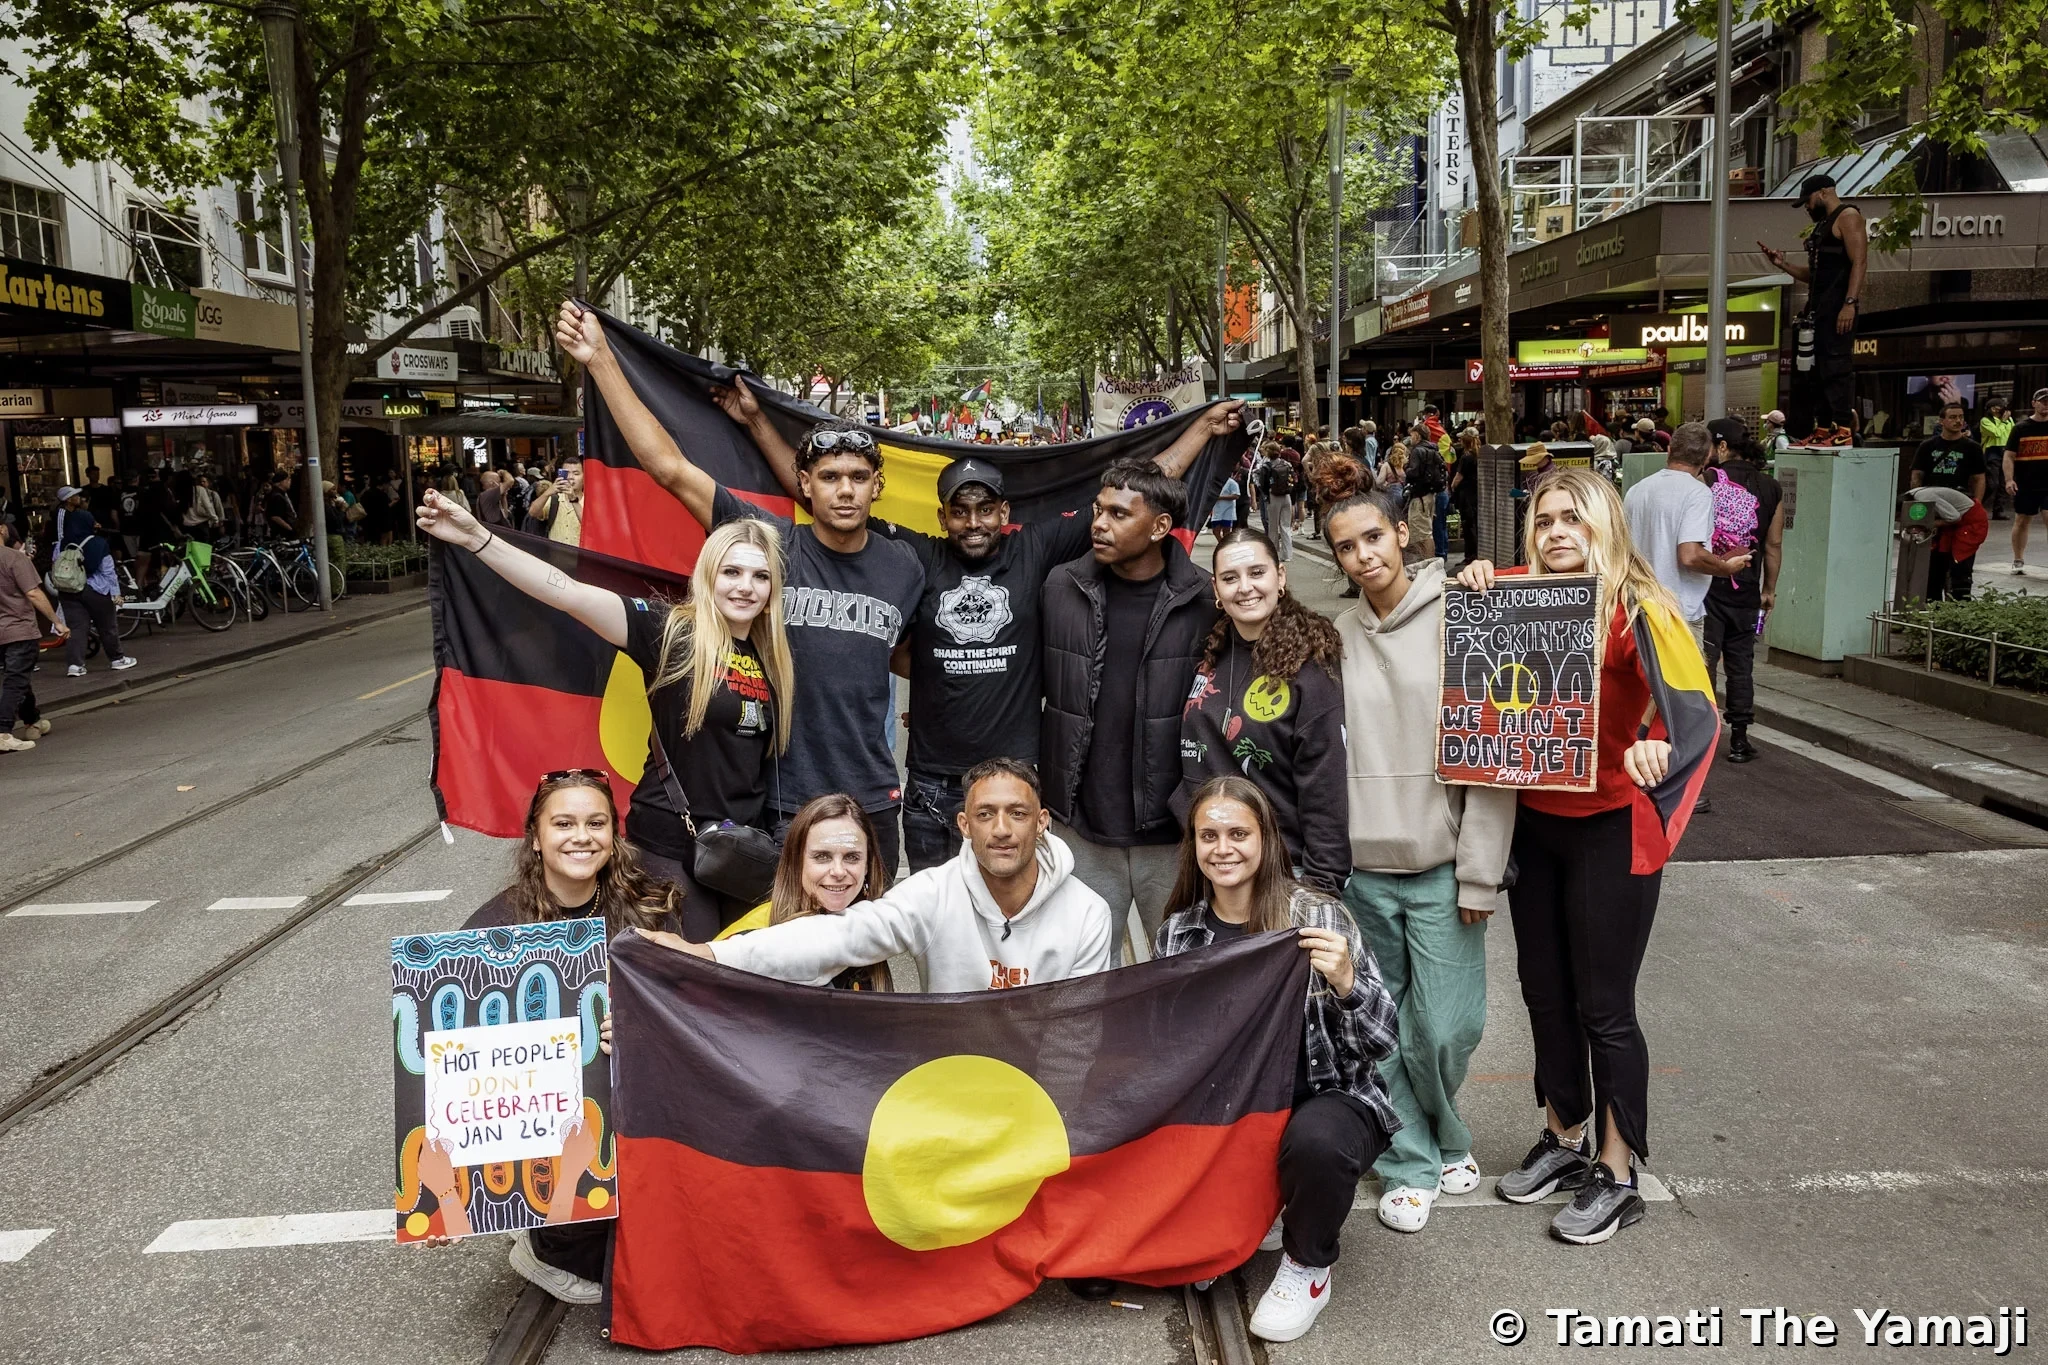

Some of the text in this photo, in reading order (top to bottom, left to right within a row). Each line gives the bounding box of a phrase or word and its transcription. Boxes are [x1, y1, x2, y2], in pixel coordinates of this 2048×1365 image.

[1866, 203, 2006, 242] pl bram
[1576, 224, 1624, 266] diamonds
[141, 302, 187, 329] gopals
[198, 305, 222, 325] UGG
[1641, 315, 1745, 346] paul brm
[403, 353, 449, 371] CROSSWAYS
[500, 349, 551, 376] PLATYPUS
[1097, 370, 1200, 394] AGAINST REMOVALS
[171, 408, 238, 424] Mind Games
[1487, 587, 1591, 608] THOUSAND
[782, 586, 903, 647] DICKIES
[933, 645, 1018, 659] SHARE THE SPIRIT
[943, 658, 1007, 671] CONTINUUM
[740, 685, 770, 703] CUSTOD
[1442, 705, 1585, 737] WE AIN'T
[1443, 734, 1594, 778] DONE YET
[444, 1042, 566, 1074] HOT PEOPLE
[446, 1092, 569, 1124] CELEBRATE
[459, 1115, 555, 1148] JAN 26!
